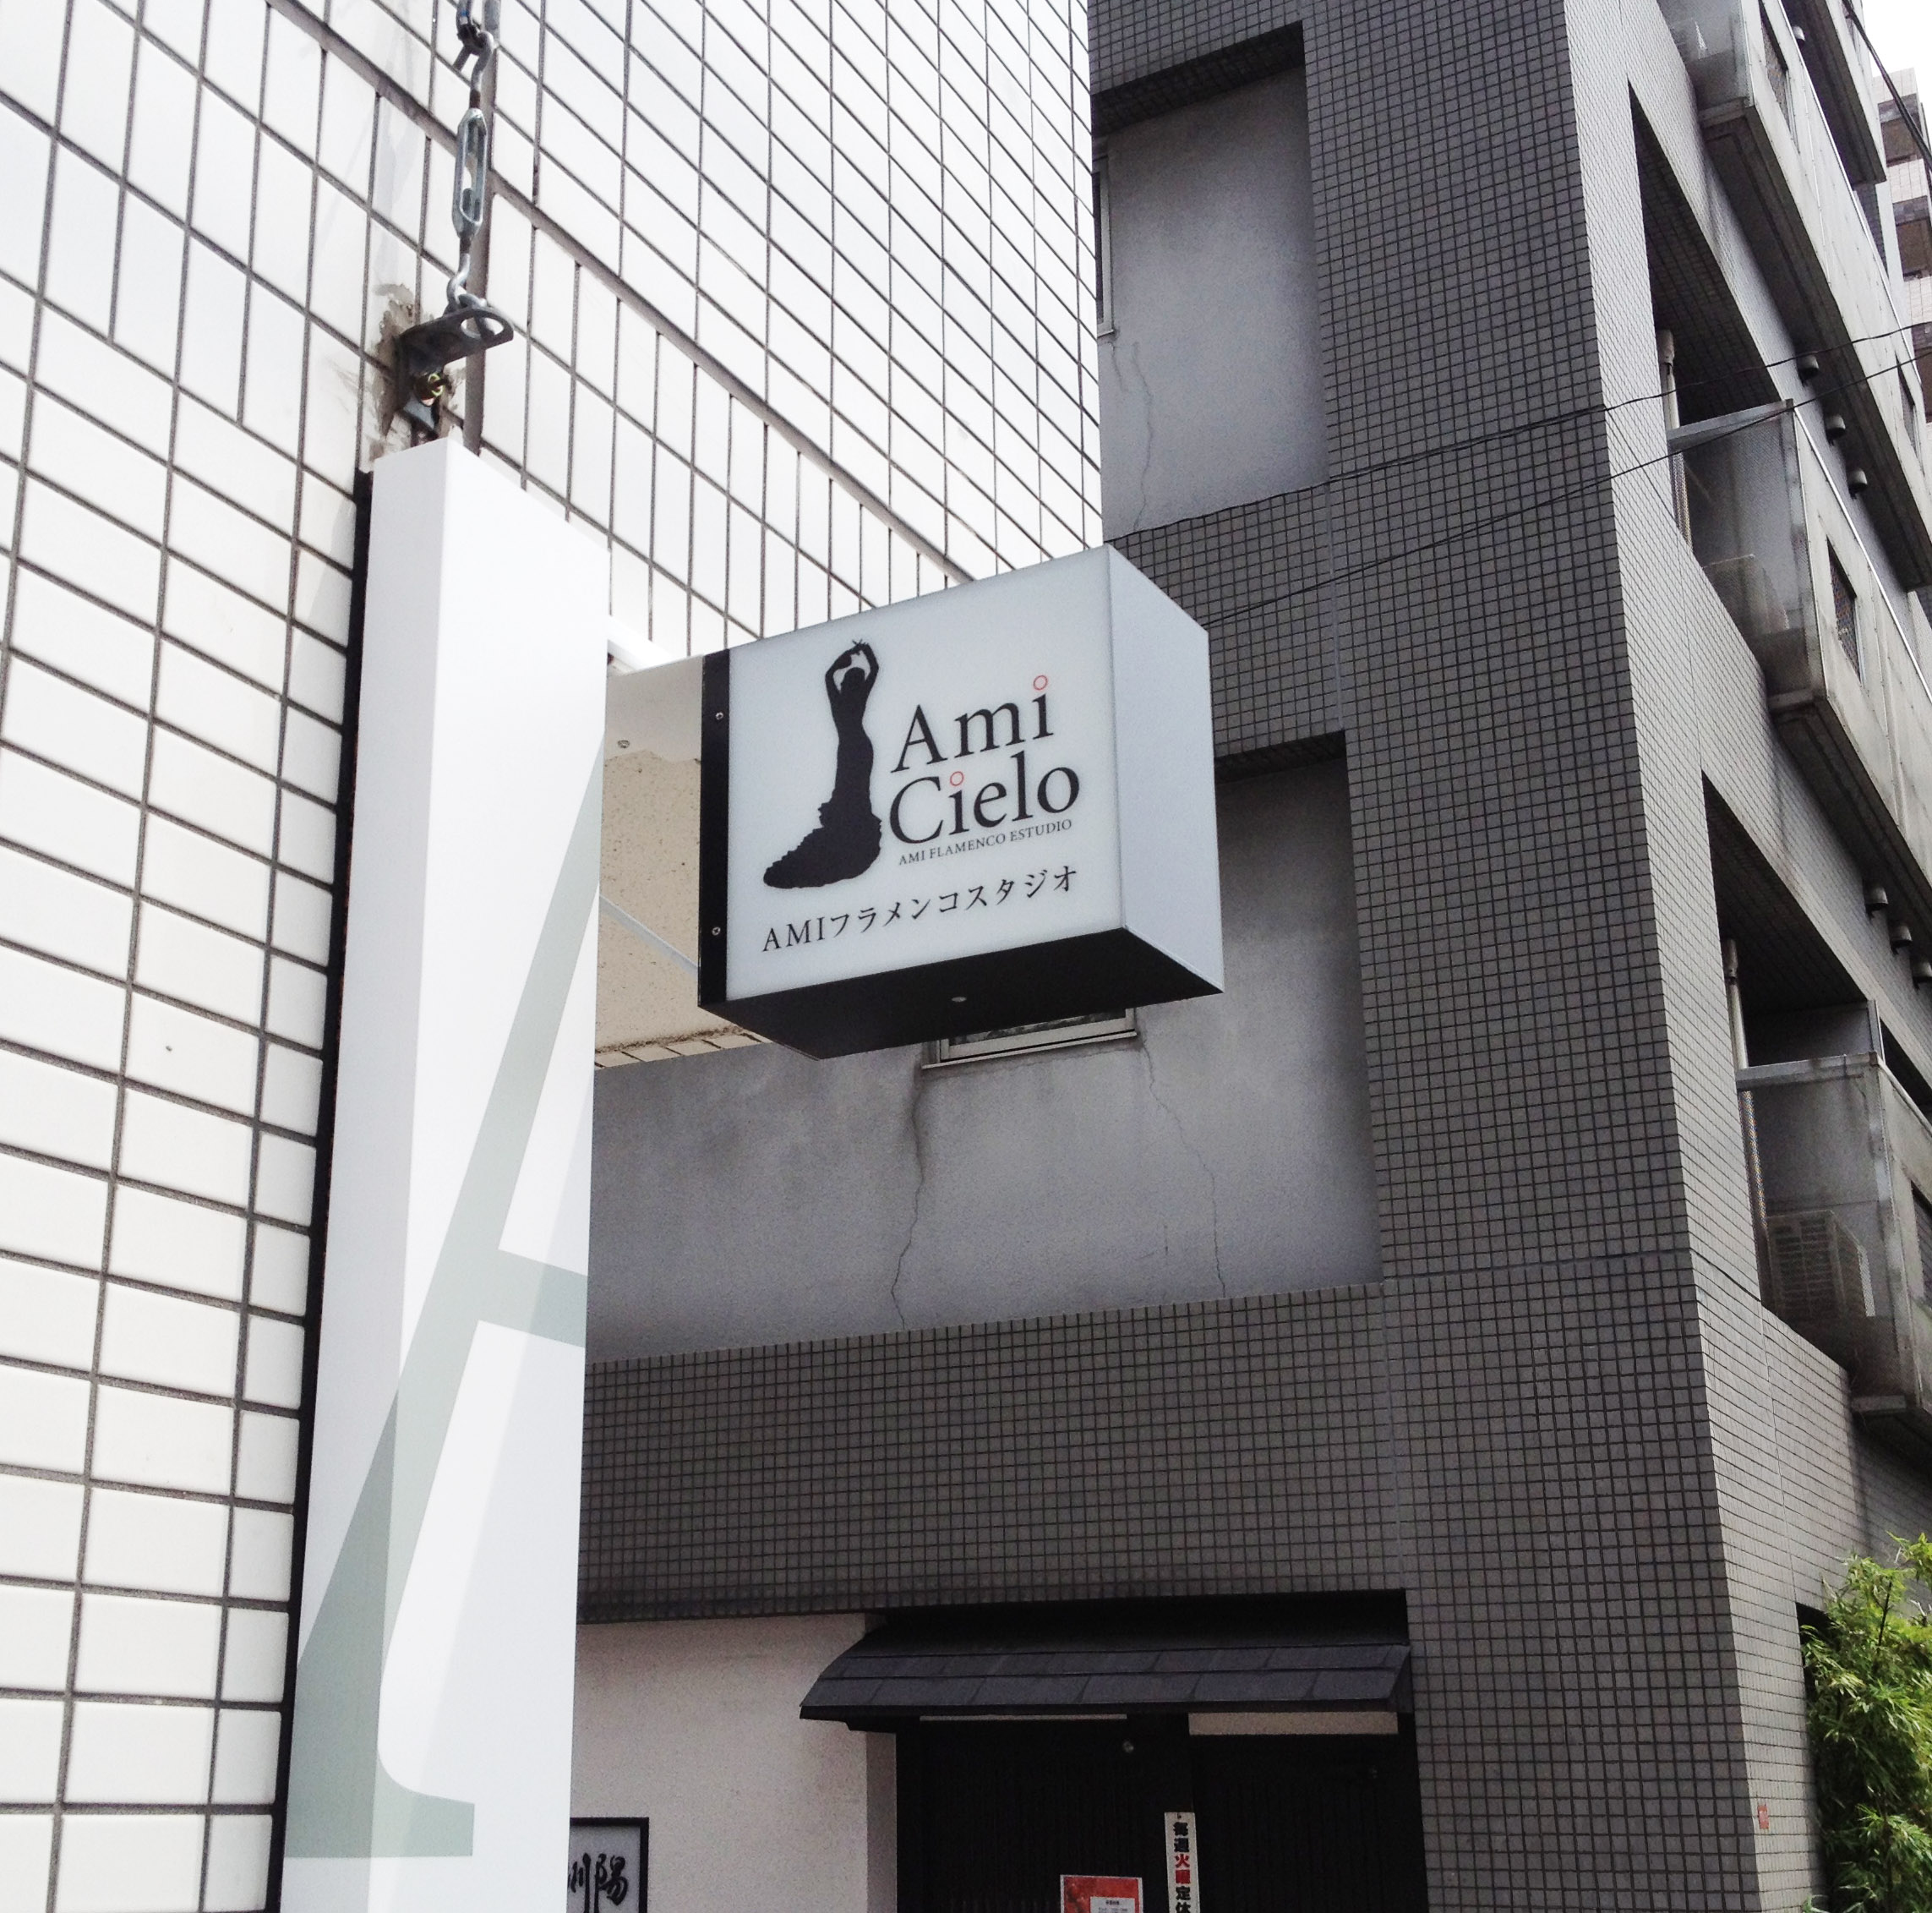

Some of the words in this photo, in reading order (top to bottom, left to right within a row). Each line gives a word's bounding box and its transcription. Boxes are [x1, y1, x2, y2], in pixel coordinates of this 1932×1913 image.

[891, 675, 1054, 773] Ami
[889, 751, 1080, 844] Cielo
[899, 850, 925, 866] AMI
[930, 834, 1006, 858] FLAMENCO
[1010, 818, 1072, 841] ESTUDIO
[762, 866, 1077, 952] AMIフラメンコスタジオ
